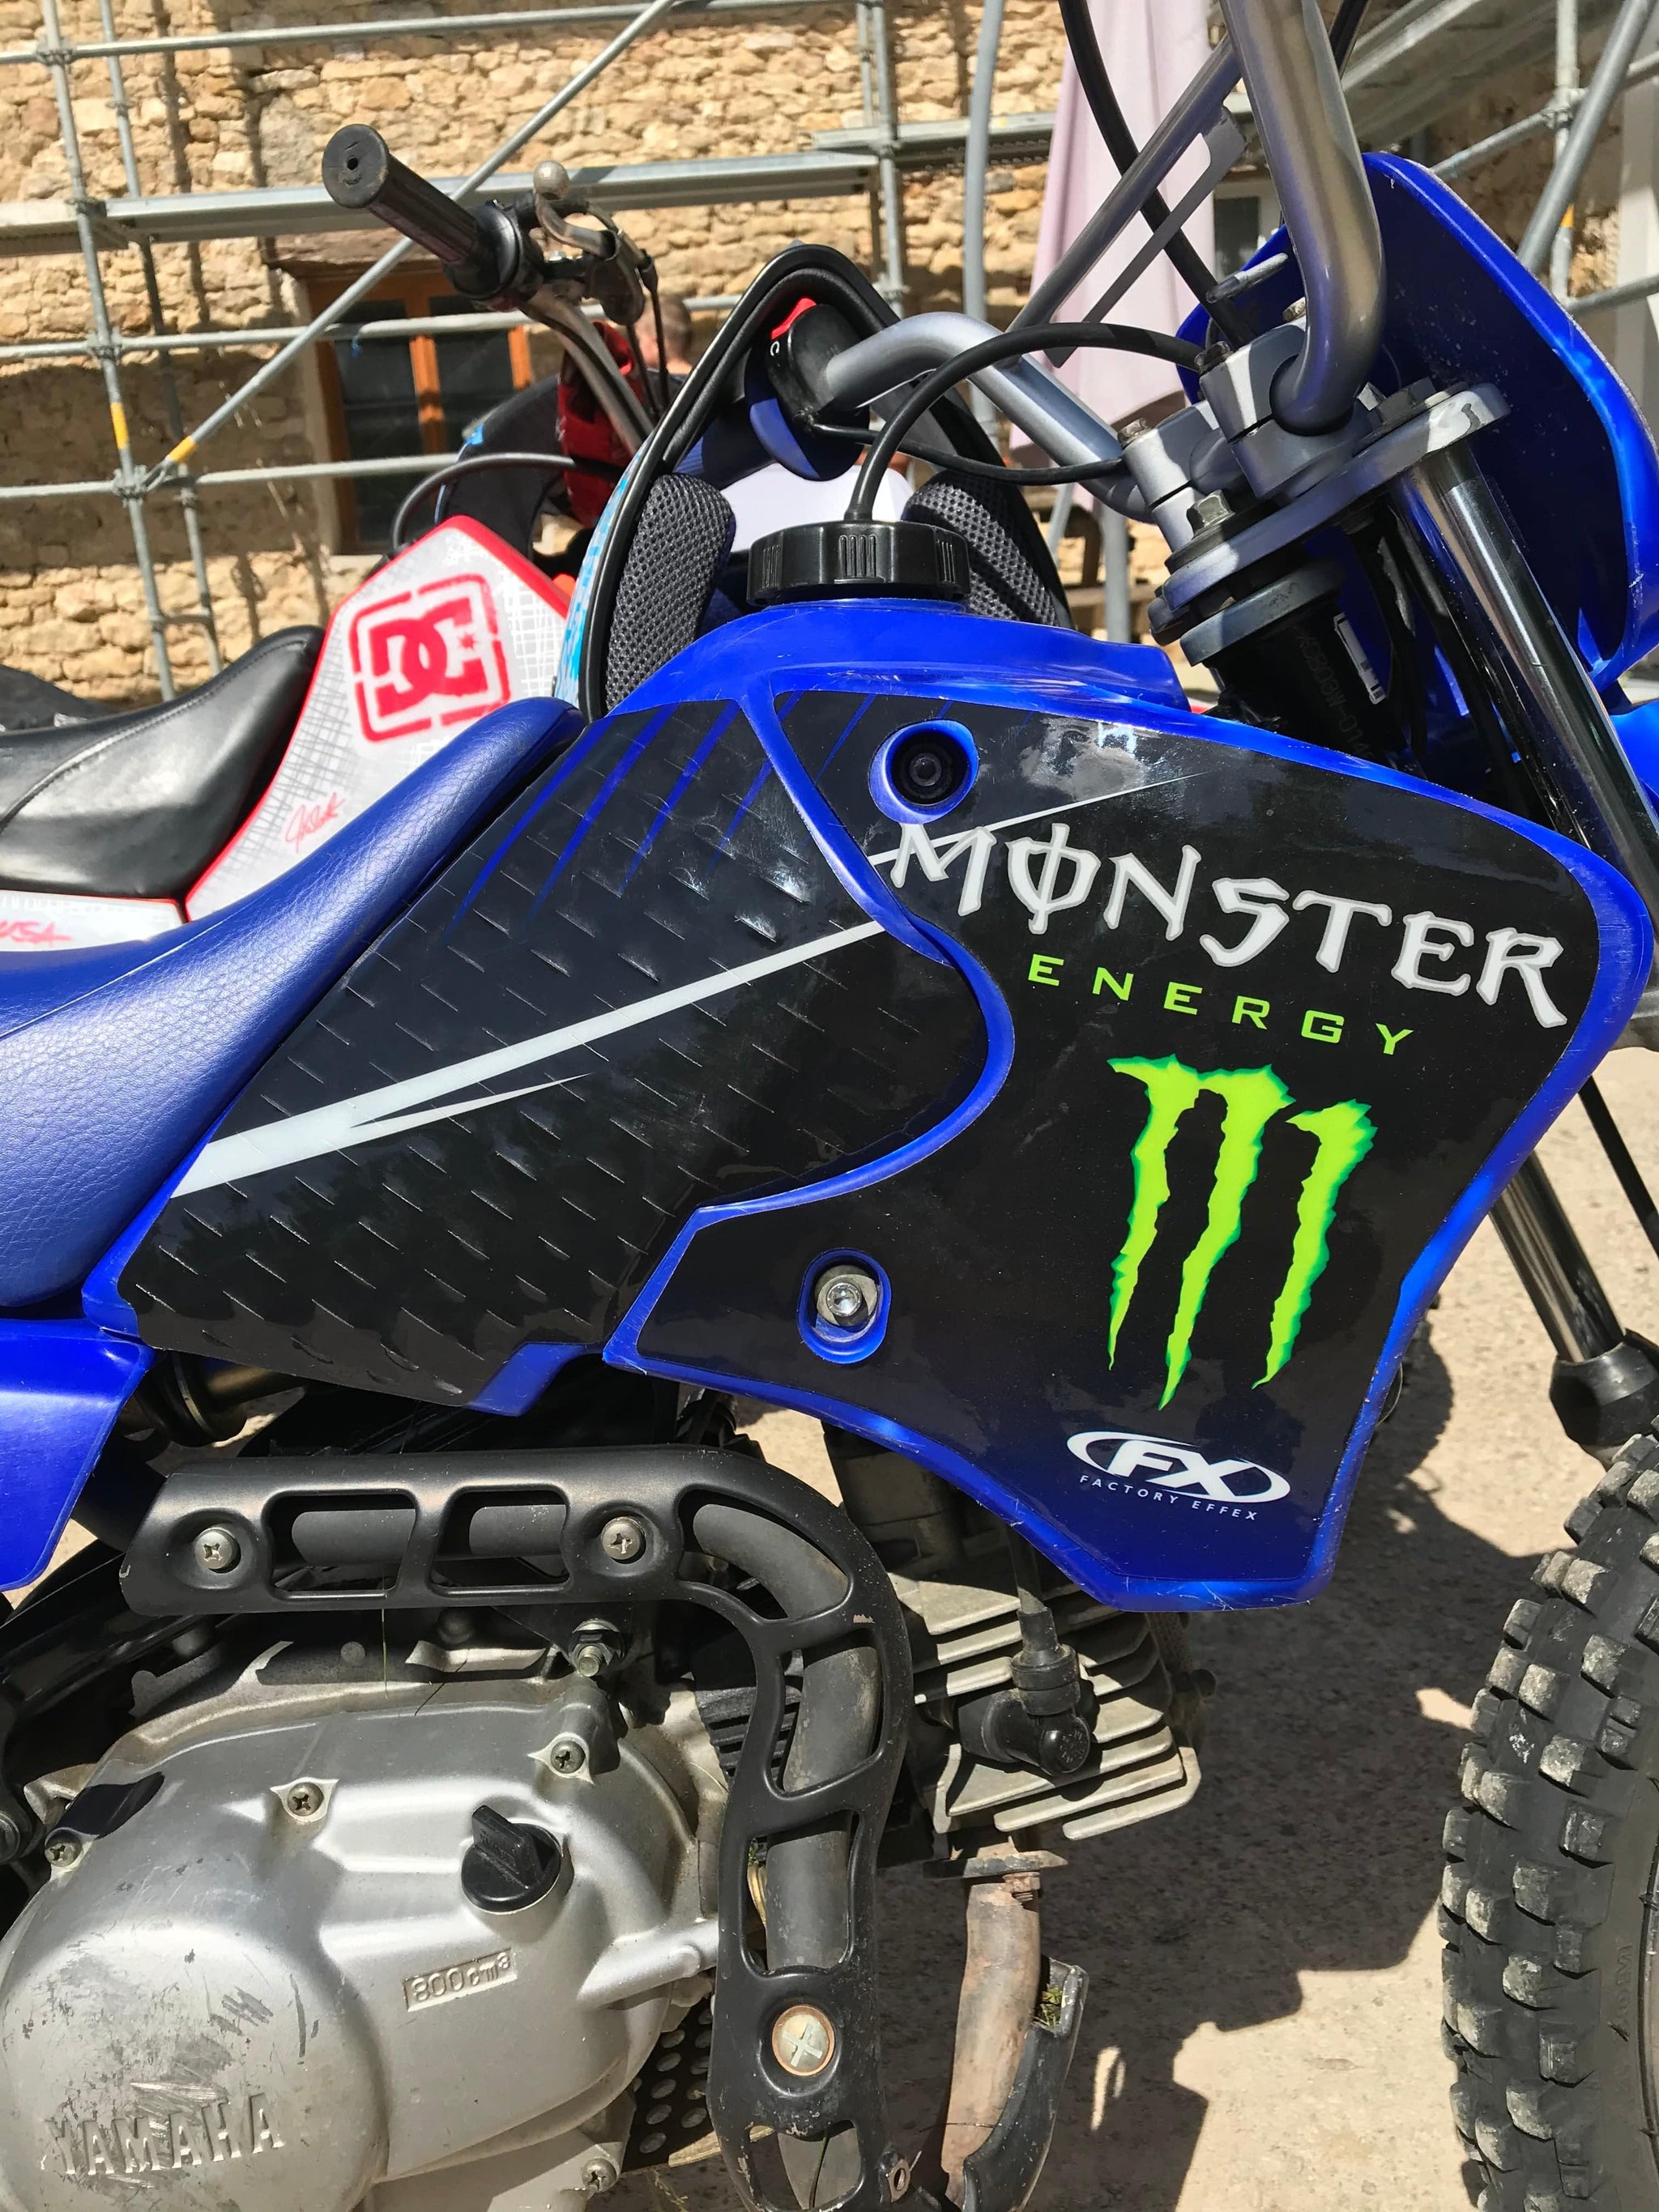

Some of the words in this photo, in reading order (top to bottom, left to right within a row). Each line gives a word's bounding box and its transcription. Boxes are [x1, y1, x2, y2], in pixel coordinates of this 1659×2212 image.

[369, 595, 487, 718] DC
[891, 821, 1568, 1029] MONSTER
[1029, 953, 1413, 1055] ENERGY
[1080, 1475, 1179, 1504] FACTORY
[1192, 1500, 1258, 1521] EFFEX
[1107, 1440, 1256, 1497] FX
[44, 2092, 284, 2175] YAMAHA
